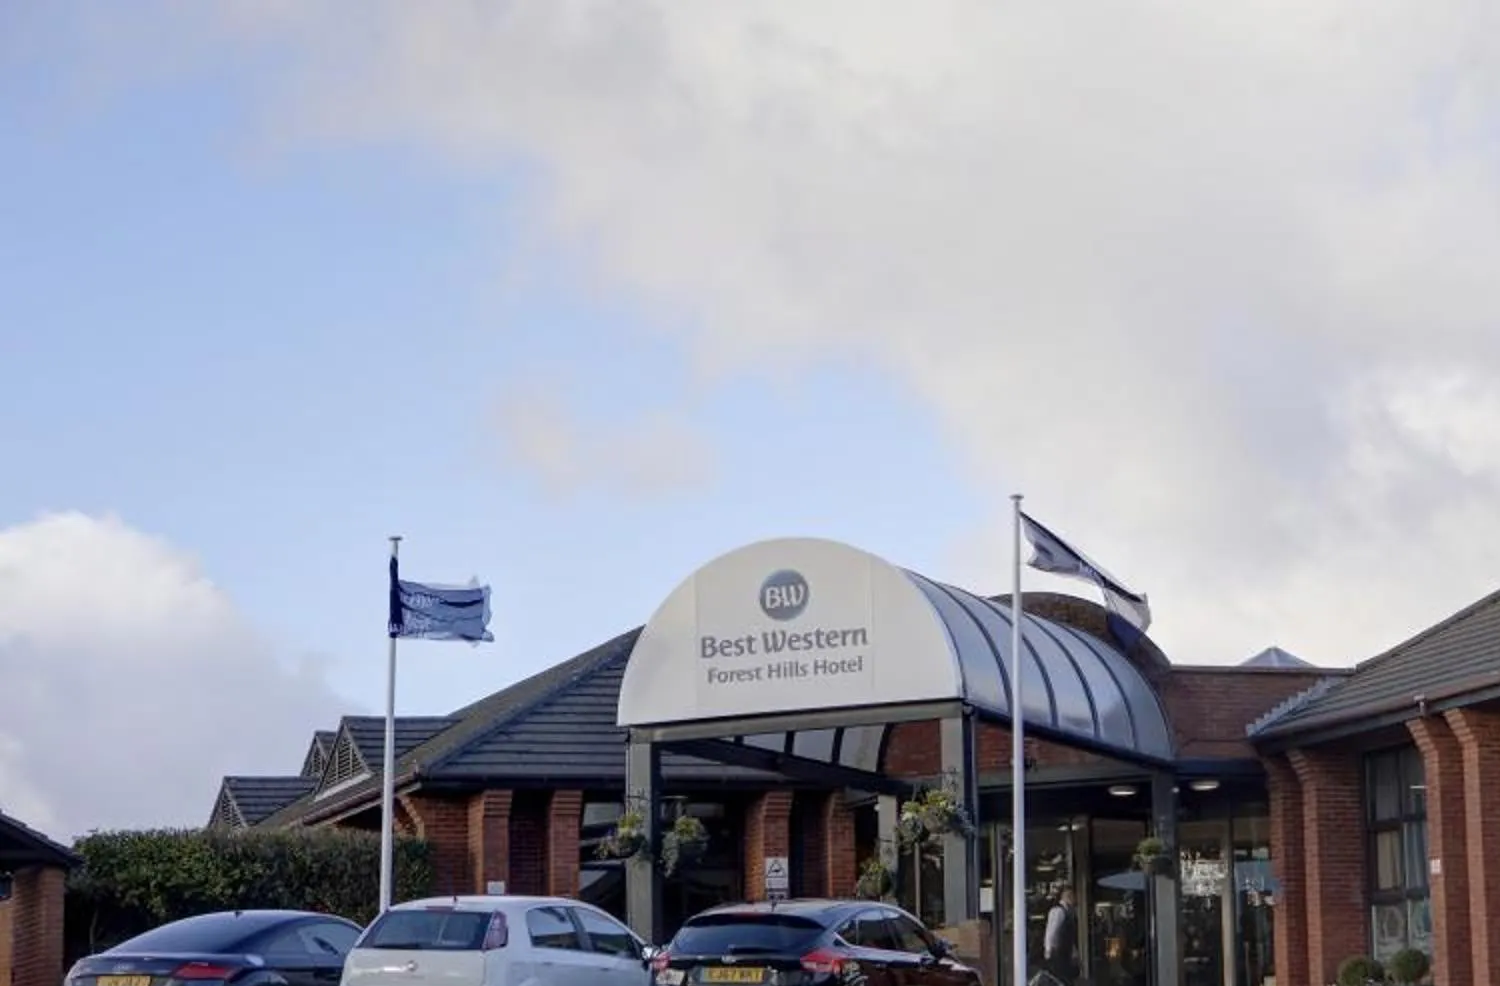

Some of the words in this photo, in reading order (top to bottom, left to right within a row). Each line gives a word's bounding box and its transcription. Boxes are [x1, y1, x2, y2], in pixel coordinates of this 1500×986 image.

[764, 584, 806, 609] BW
[701, 634, 757, 659] Best
[761, 627, 869, 654] Western
[707, 666, 762, 684] Forest
[767, 660, 808, 680] Hills
[813, 656, 863, 676] Hotel
